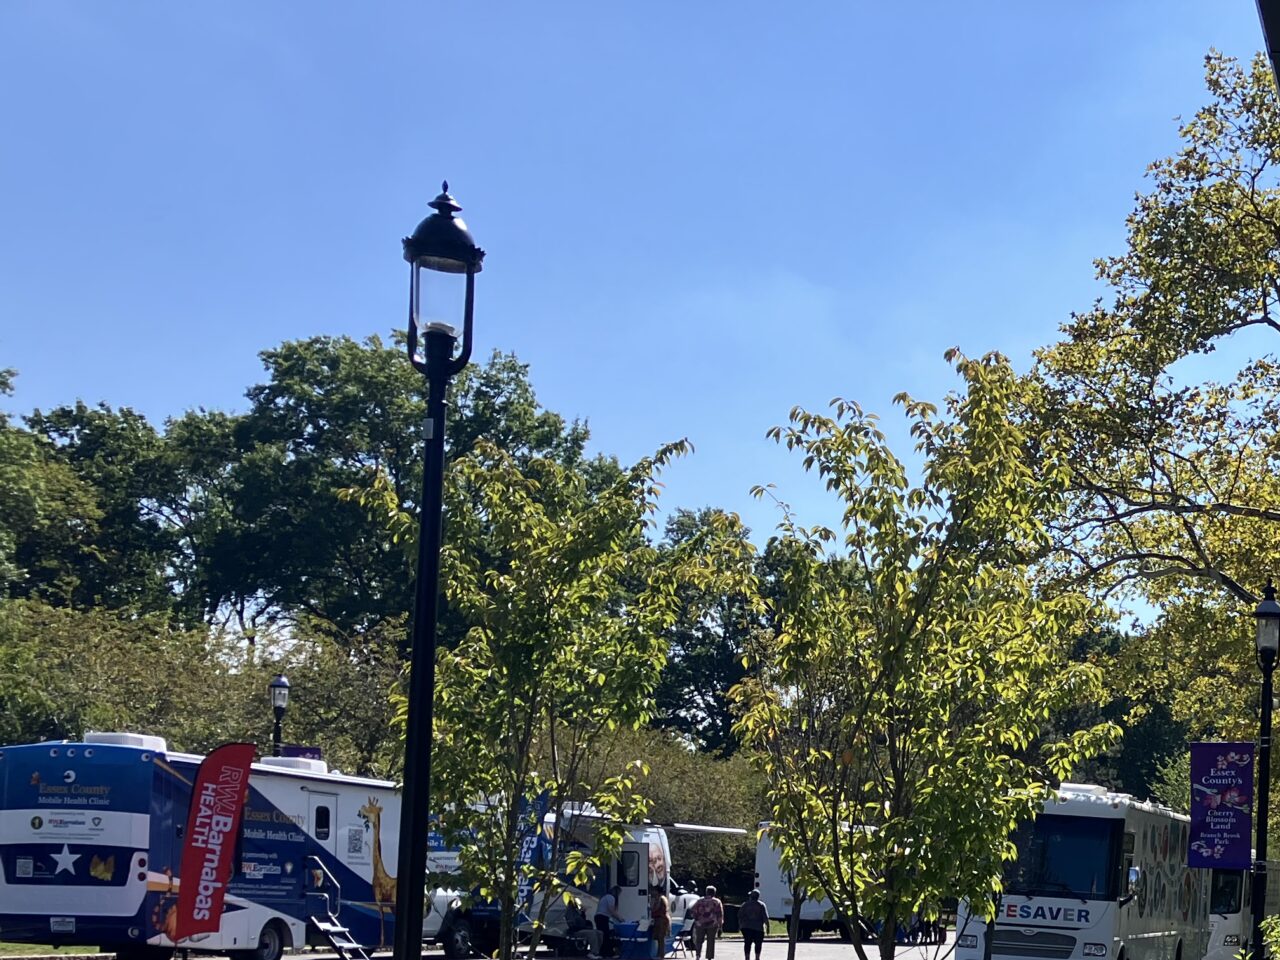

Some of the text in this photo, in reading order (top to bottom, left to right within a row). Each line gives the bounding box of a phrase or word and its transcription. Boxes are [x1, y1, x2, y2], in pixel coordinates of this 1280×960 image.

[1210, 768, 1236, 777] Essex
[192, 783, 216, 848] HEALTH
[1208, 810, 1234, 818] Cherry
[1210, 822, 1231, 830] Land
